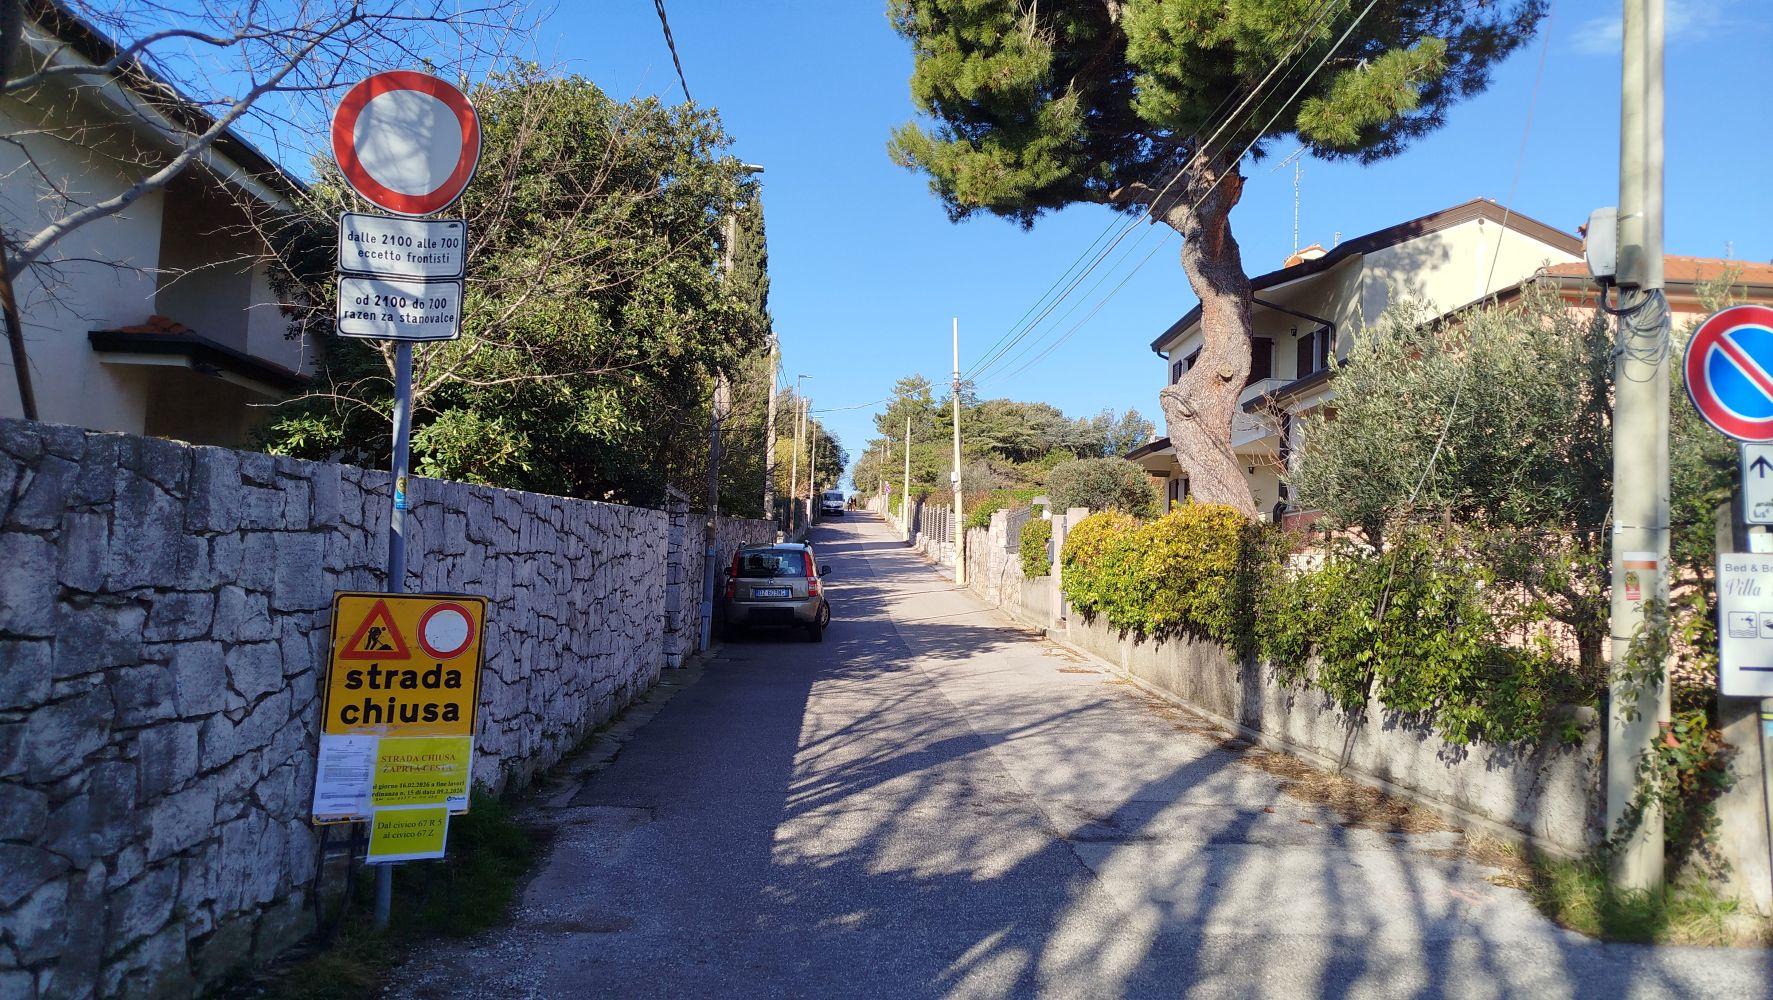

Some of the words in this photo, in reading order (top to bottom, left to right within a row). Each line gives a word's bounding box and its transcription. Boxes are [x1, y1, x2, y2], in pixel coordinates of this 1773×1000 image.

[347, 231, 377, 244] dalle
[417, 236, 437, 249] alle
[357, 249, 401, 261] eccetto
[406, 251, 450, 264] frontisti
[355, 294, 369, 306] od
[412, 297, 425, 310] do
[344, 309, 376, 321] razen
[381, 312, 394, 322] za
[399, 312, 454, 324] stanovalce
[1725, 563, 1747, 572] Bed
[1750, 563, 1758, 572] &
[1725, 577, 1761, 597] Villa
[344, 662, 462, 690] strada
[340, 696, 460, 725] chiusa
[381, 755, 419, 763] STRADA
[421, 753, 456, 762] CHIUSA
[377, 821, 392, 830] Dal
[393, 820, 417, 829] civico
[418, 819, 428, 827] 67
[429, 819, 435, 827] R
[391, 830, 416, 839] civico
[416, 829, 427, 837] 67
[428, 829, 434, 837] Z
